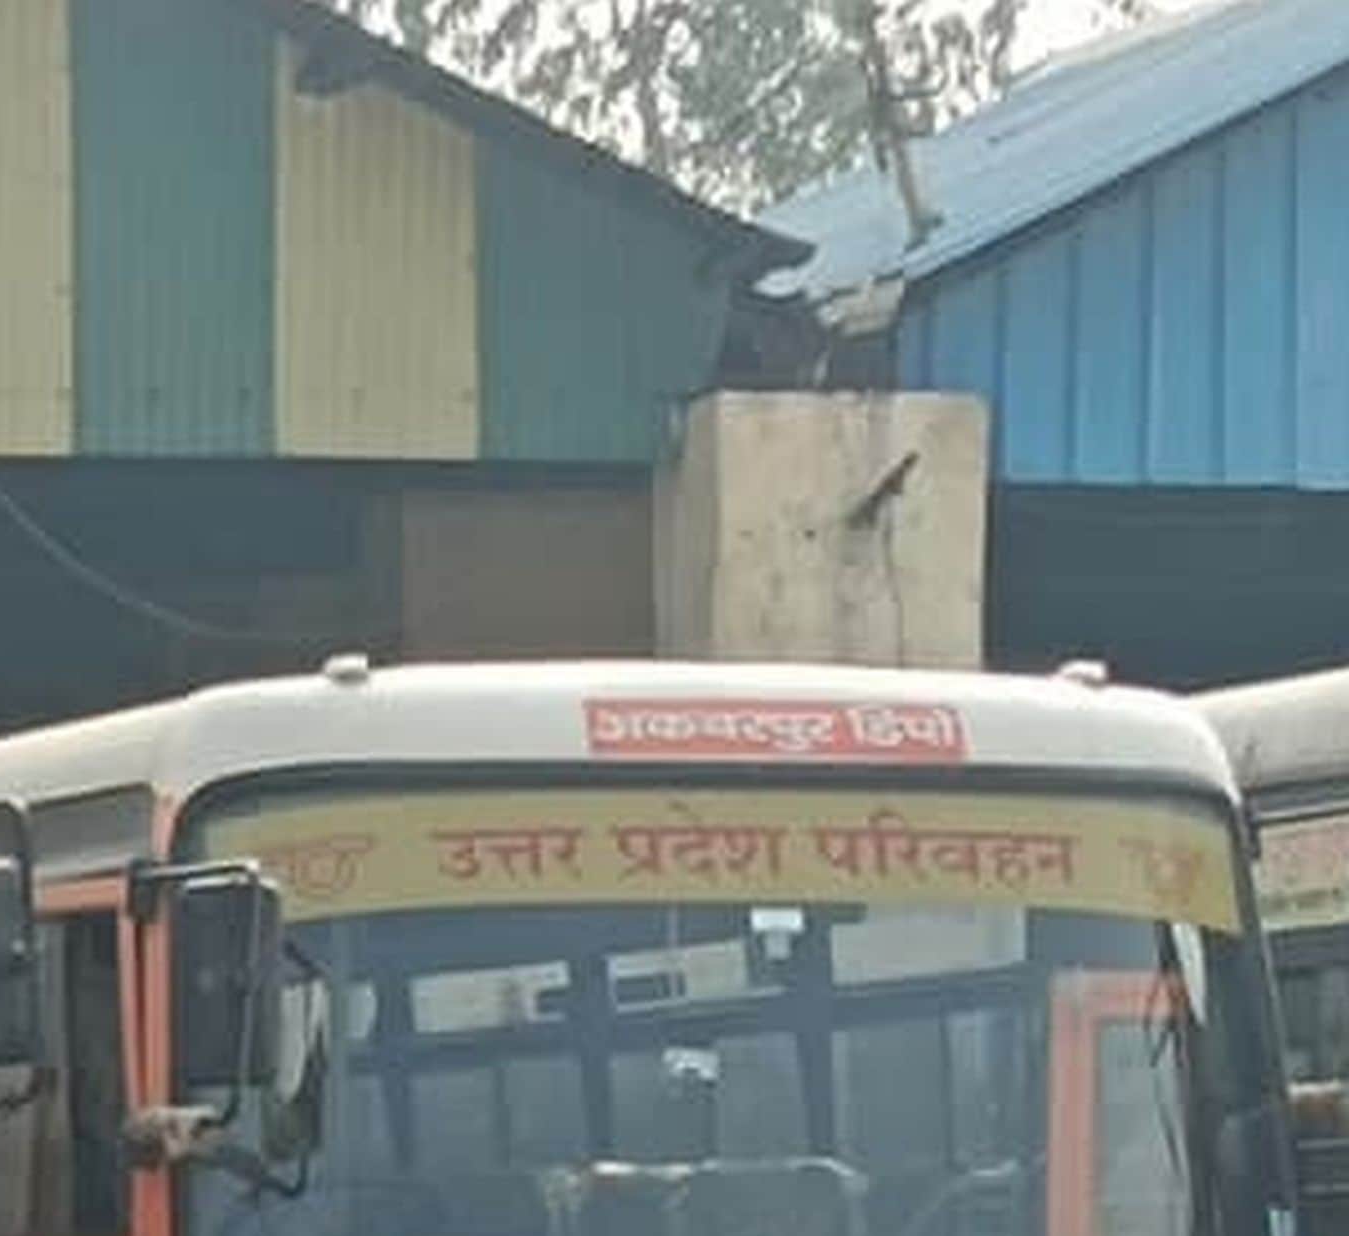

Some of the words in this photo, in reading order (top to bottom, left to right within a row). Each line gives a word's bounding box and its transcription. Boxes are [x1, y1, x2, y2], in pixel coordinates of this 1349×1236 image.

[429, 827, 582, 881] उत्तर
[610, 799, 789, 883] प्रदेश
[809, 808, 1080, 885] परिवहन
